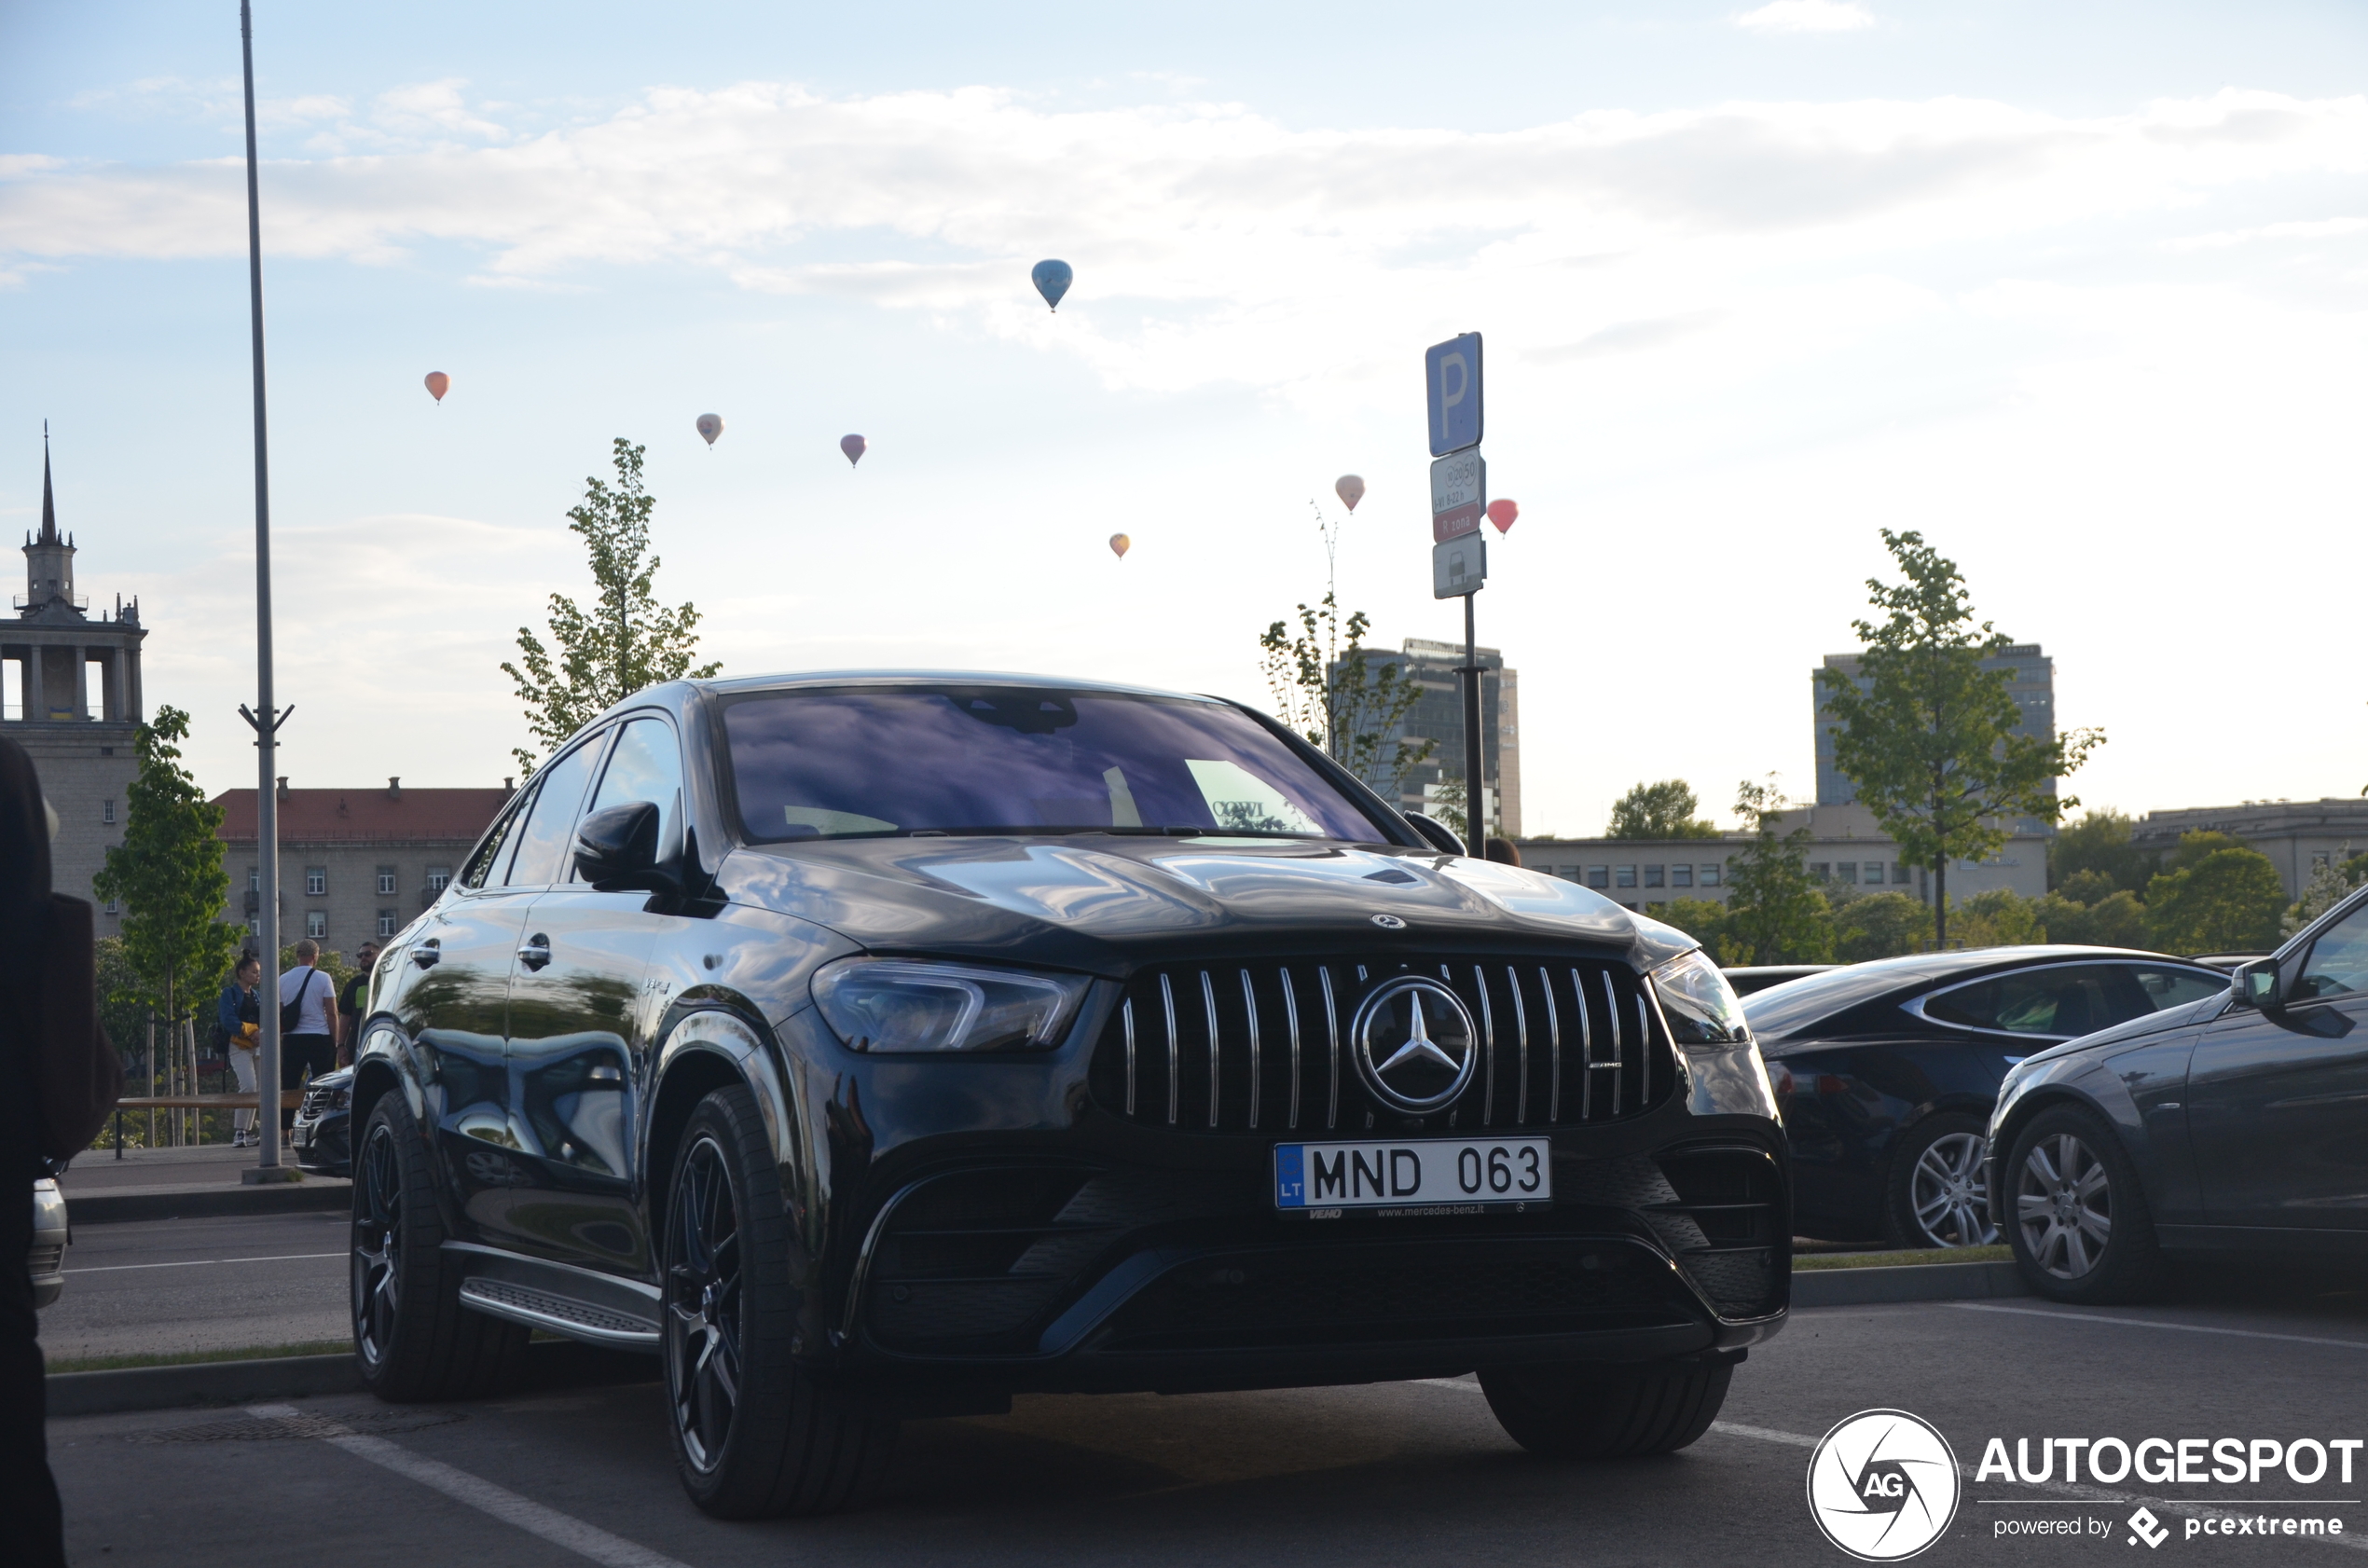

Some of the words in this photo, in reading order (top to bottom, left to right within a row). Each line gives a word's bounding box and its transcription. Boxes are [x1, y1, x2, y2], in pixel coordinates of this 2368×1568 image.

[1440, 352, 1468, 439] P
[1454, 467, 1463, 481] 20
[1465, 462, 1475, 479] 50
[1446, 491, 1459, 506] 8-22
[1460, 489, 1465, 501] h
[1442, 520, 1449, 534] R
[1452, 516, 1470, 531] zona
[1314, 1148, 1422, 1199] MND
[1458, 1146, 1541, 1194] 063
[1281, 1183, 1301, 1197] LT
[1310, 1208, 1342, 1219] VEHO
[1377, 1204, 1484, 1217] www.mercedes-benz.lt
